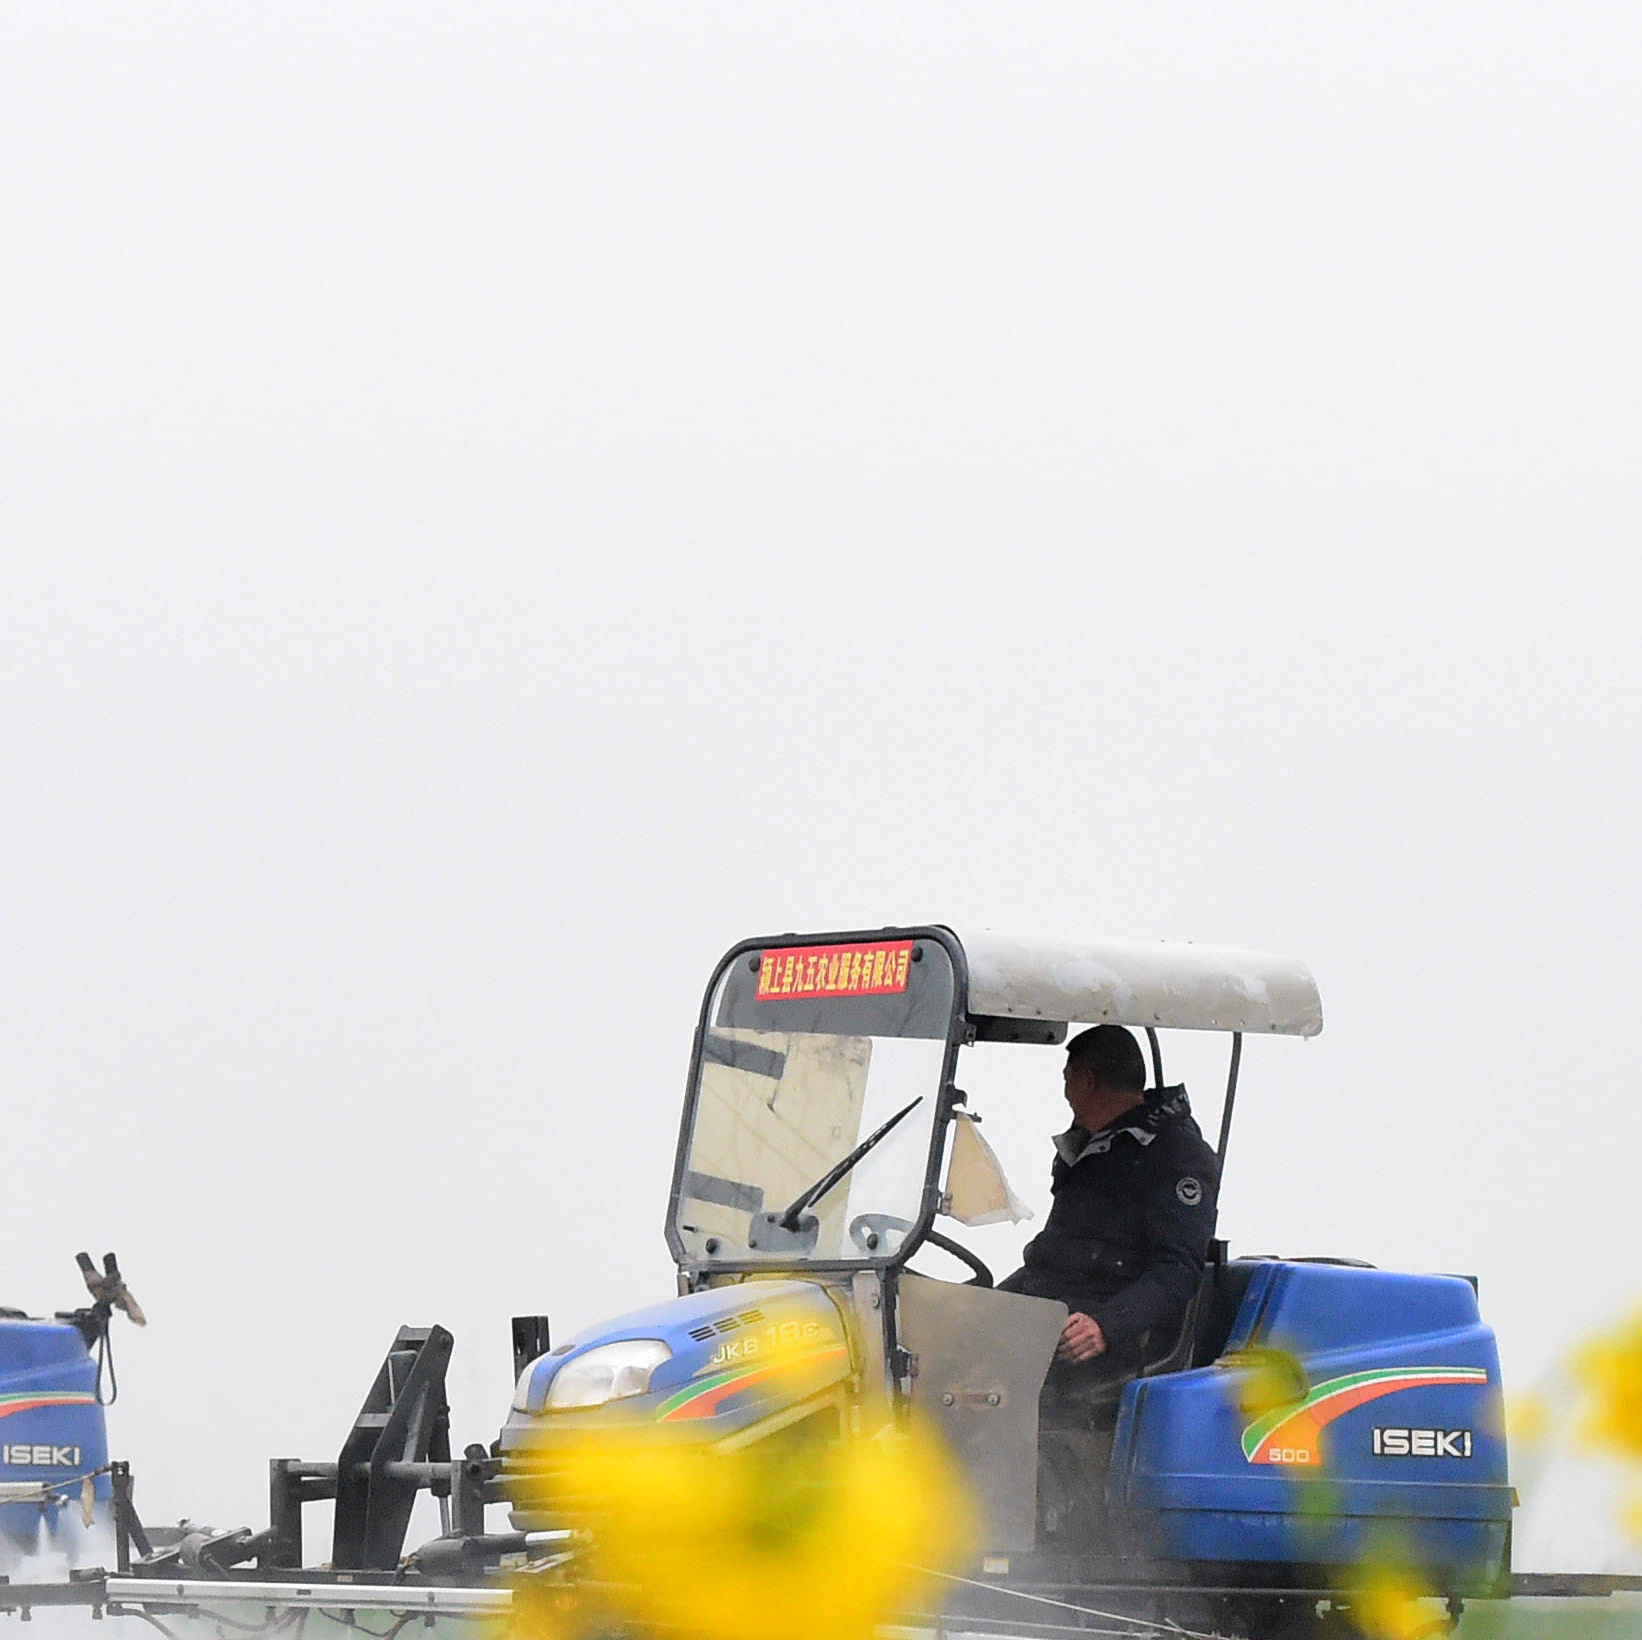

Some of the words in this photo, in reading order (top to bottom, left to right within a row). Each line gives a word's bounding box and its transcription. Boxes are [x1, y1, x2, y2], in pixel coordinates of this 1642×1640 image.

[711, 1338, 758, 1364] JKB
[2, 1444, 81, 1466] ISEKI
[1373, 1427, 1472, 1457] ISEKI
